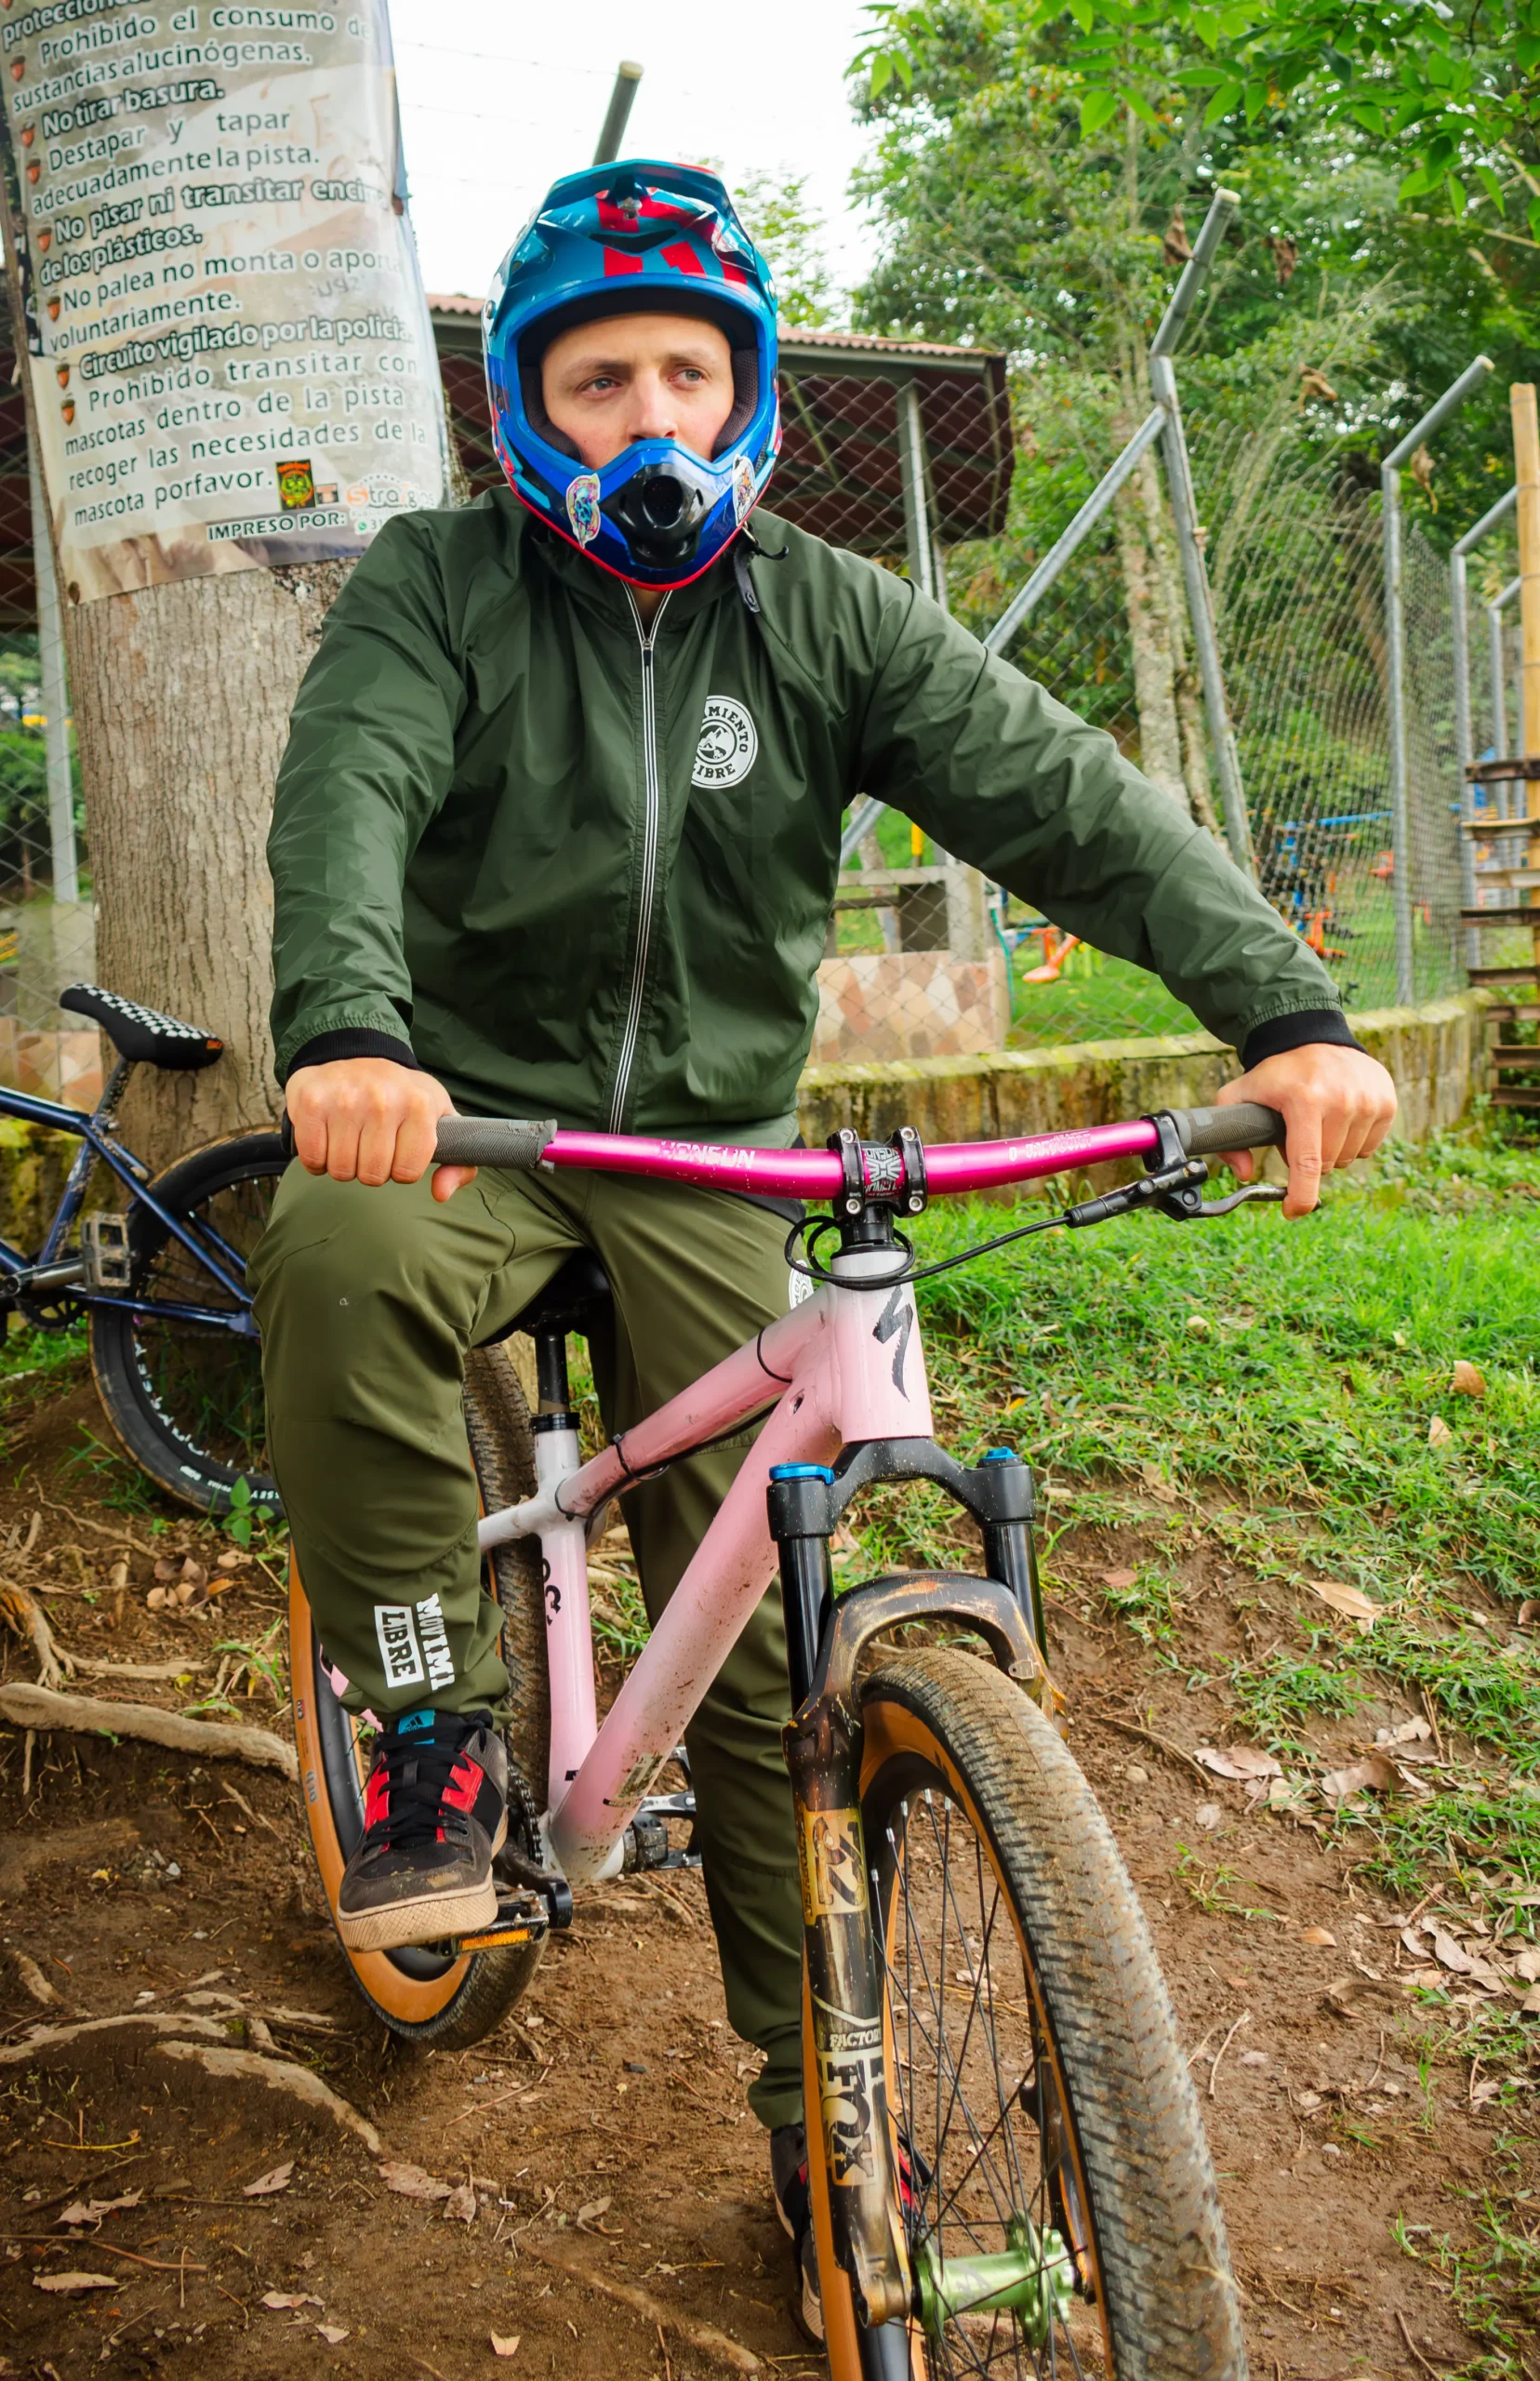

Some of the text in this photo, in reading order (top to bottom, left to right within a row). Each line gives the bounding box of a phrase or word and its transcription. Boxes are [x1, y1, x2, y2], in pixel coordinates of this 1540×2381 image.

[3, 0, 150, 52] proteccion
[41, 17, 155, 63] Prohibido
[173, 9, 195, 30] el
[213, 9, 335, 31] consumo
[14, 41, 311, 112] sustancias alucinógenas.
[123, 78, 226, 113] basura.
[49, 113, 290, 171] Destapar y tapar
[33, 144, 320, 215] adecuadamente la pista.
[55, 216, 85, 245] No
[89, 198, 143, 239] pisar
[149, 187, 175, 216] ni
[181, 178, 304, 207] transitar
[92, 224, 204, 273] plásticos.
[63, 289, 91, 312] No
[98, 271, 154, 307] palea
[163, 262, 194, 283] no
[206, 251, 294, 275] monta
[304, 252, 319, 269] o
[50, 291, 241, 352] voluntariamente.
[79, 341, 157, 379] Circuito
[157, 320, 259, 361] vigilado
[260, 322, 308, 351] por
[308, 314, 335, 340] la
[89, 352, 417, 412] Prohibido transitar con
[65, 384, 404, 456] mascotas dentro de la pista
[69, 419, 426, 490] recoger las necesidades de la
[74, 493, 144, 526] mascota
[207, 517, 294, 540] IMPRESO
[299, 512, 346, 529] POR:
[707, 706, 749, 753] MIENTO
[694, 763, 736, 779] IBRE
[829, 2029, 882, 2047] FACTOR
[822, 2058, 875, 2180] FOX
